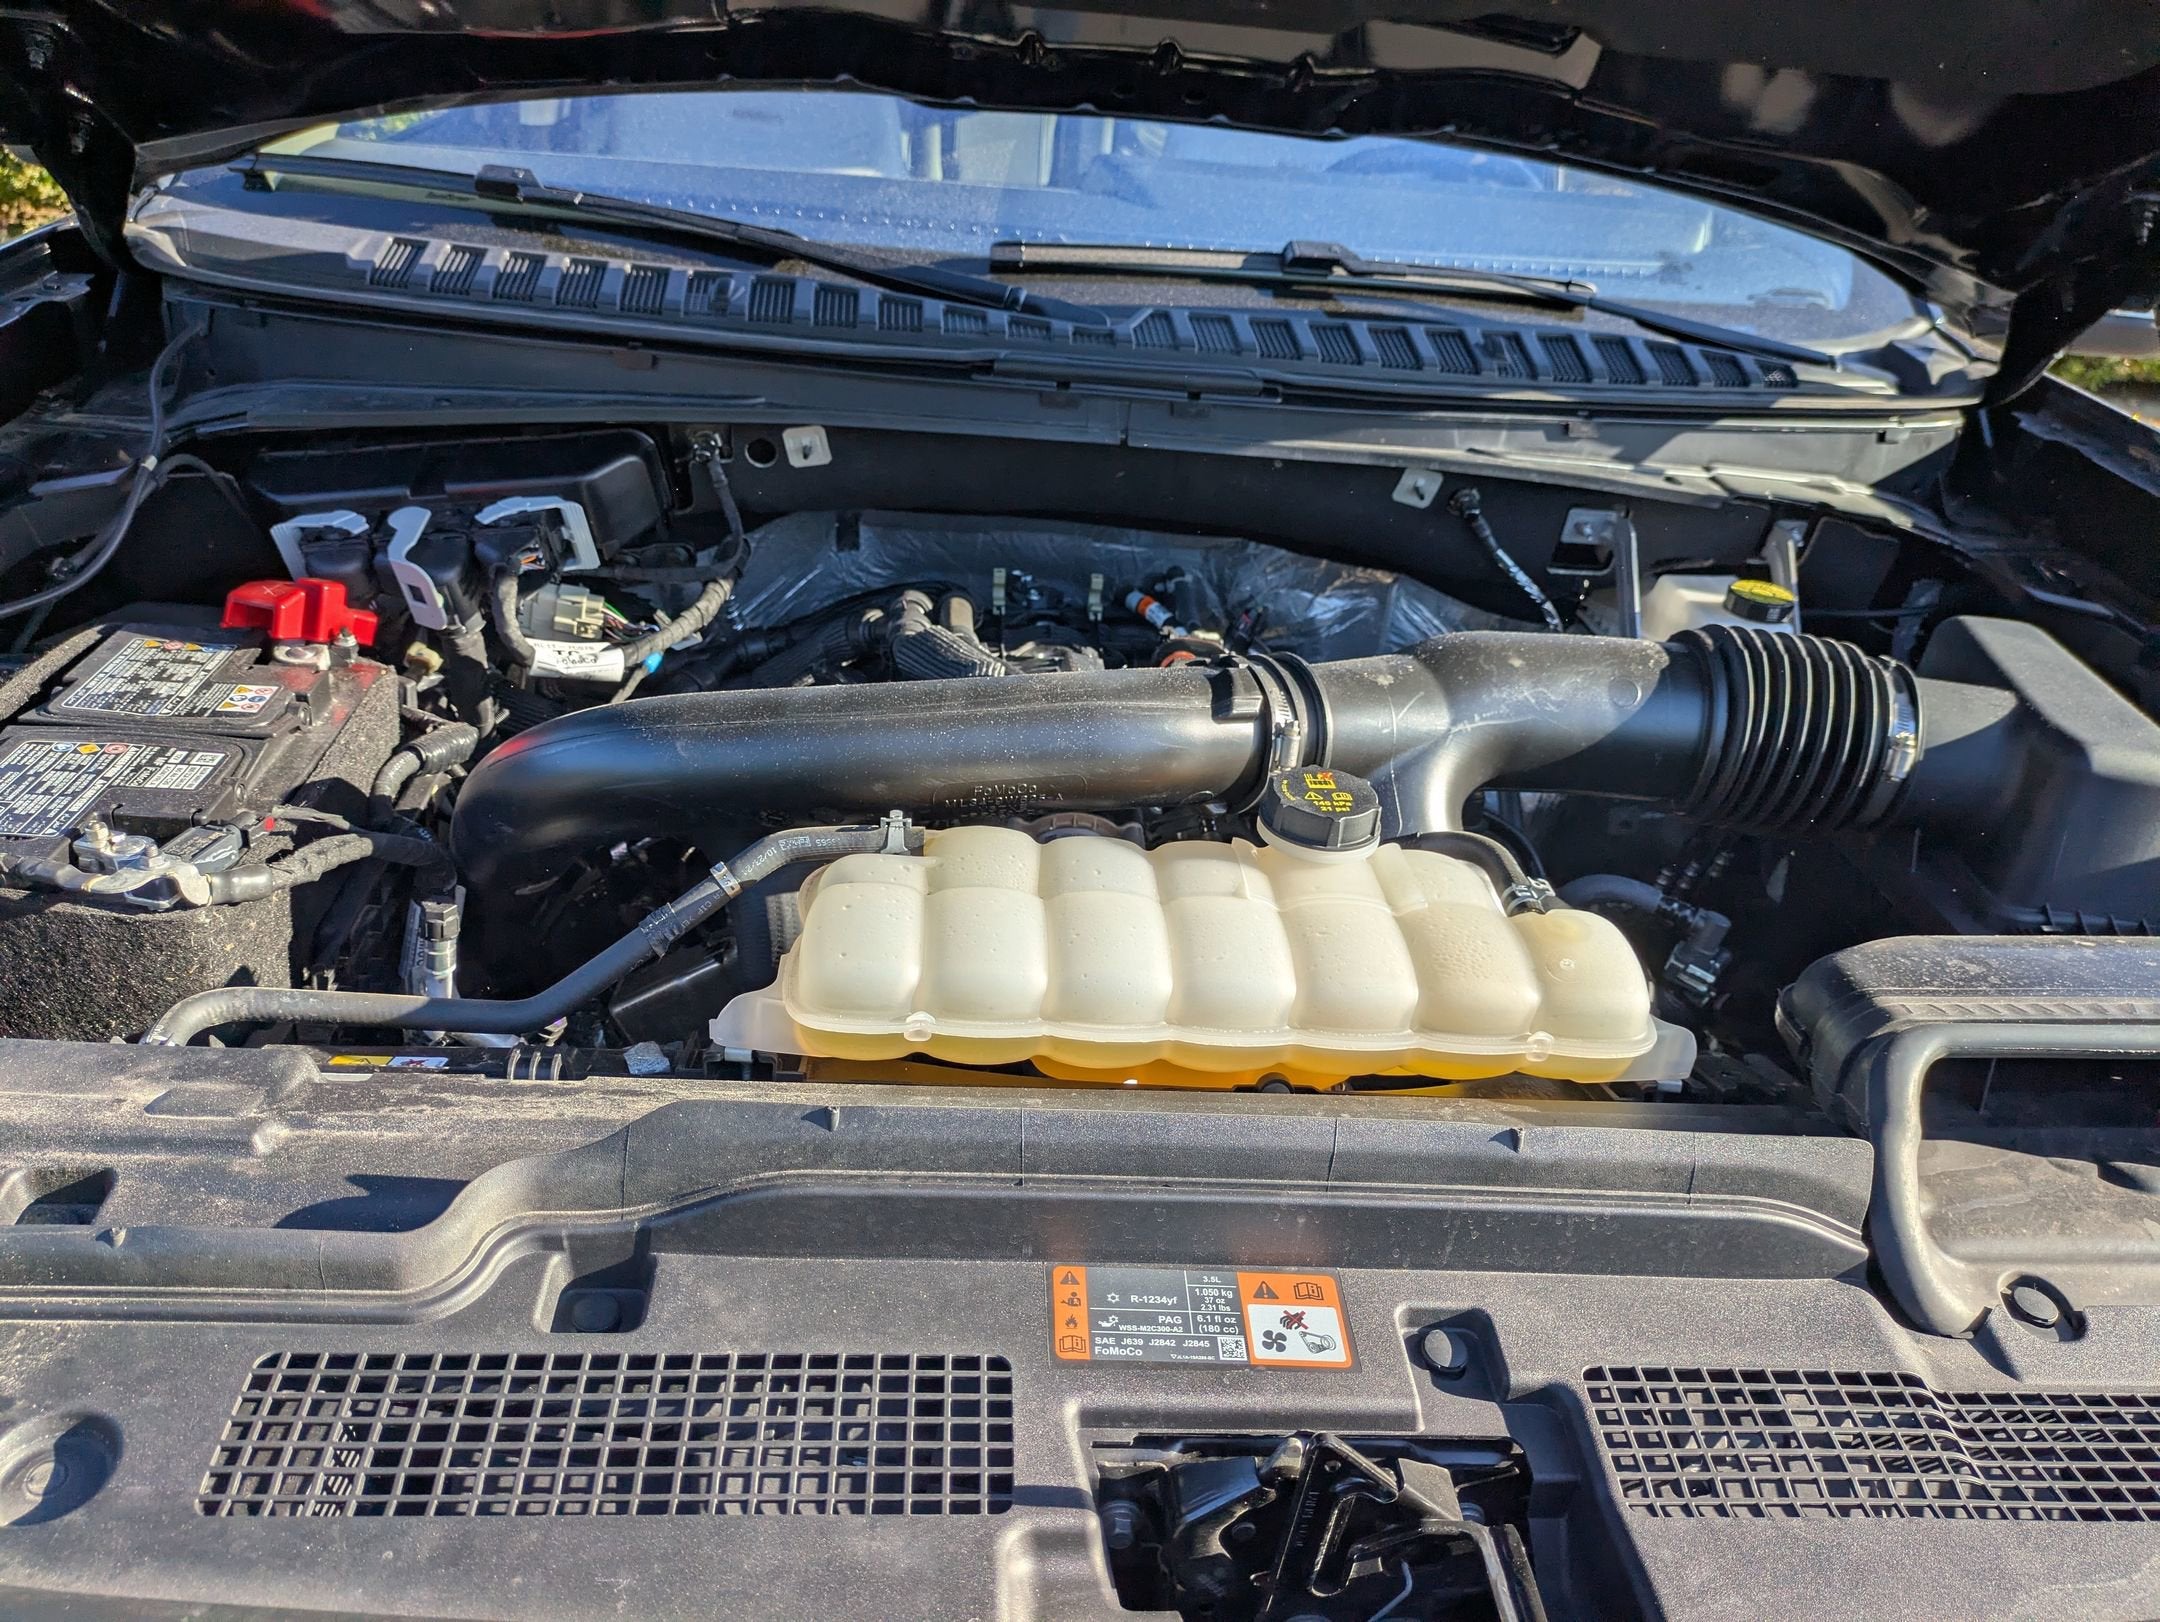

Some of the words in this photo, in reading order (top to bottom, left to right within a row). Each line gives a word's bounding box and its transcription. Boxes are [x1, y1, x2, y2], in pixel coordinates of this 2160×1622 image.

[974, 783, 1037, 796] FoMoCo
[1202, 1275, 1222, 1283] 3.5L
[1195, 1288, 1219, 1296] 1.050
[1221, 1289, 1233, 1298] kg
[1130, 1294, 1177, 1306] R-1234yf
[1200, 1303, 1217, 1311] 2.31
[1158, 1315, 1182, 1324] PAG
[1197, 1314, 1212, 1323] 6.1
[1214, 1315, 1222, 1323] fl
[1118, 1324, 1184, 1333] WSS-M2C300-A2
[1198, 1324, 1221, 1334] (180
[1222, 1326, 1239, 1335] cc)
[1094, 1336, 1116, 1345] SAE
[1120, 1337, 1144, 1346] J639
[1148, 1338, 1176, 1347] J2842
[1182, 1339, 1211, 1348] J2845
[1094, 1345, 1143, 1356] FoMoCo
